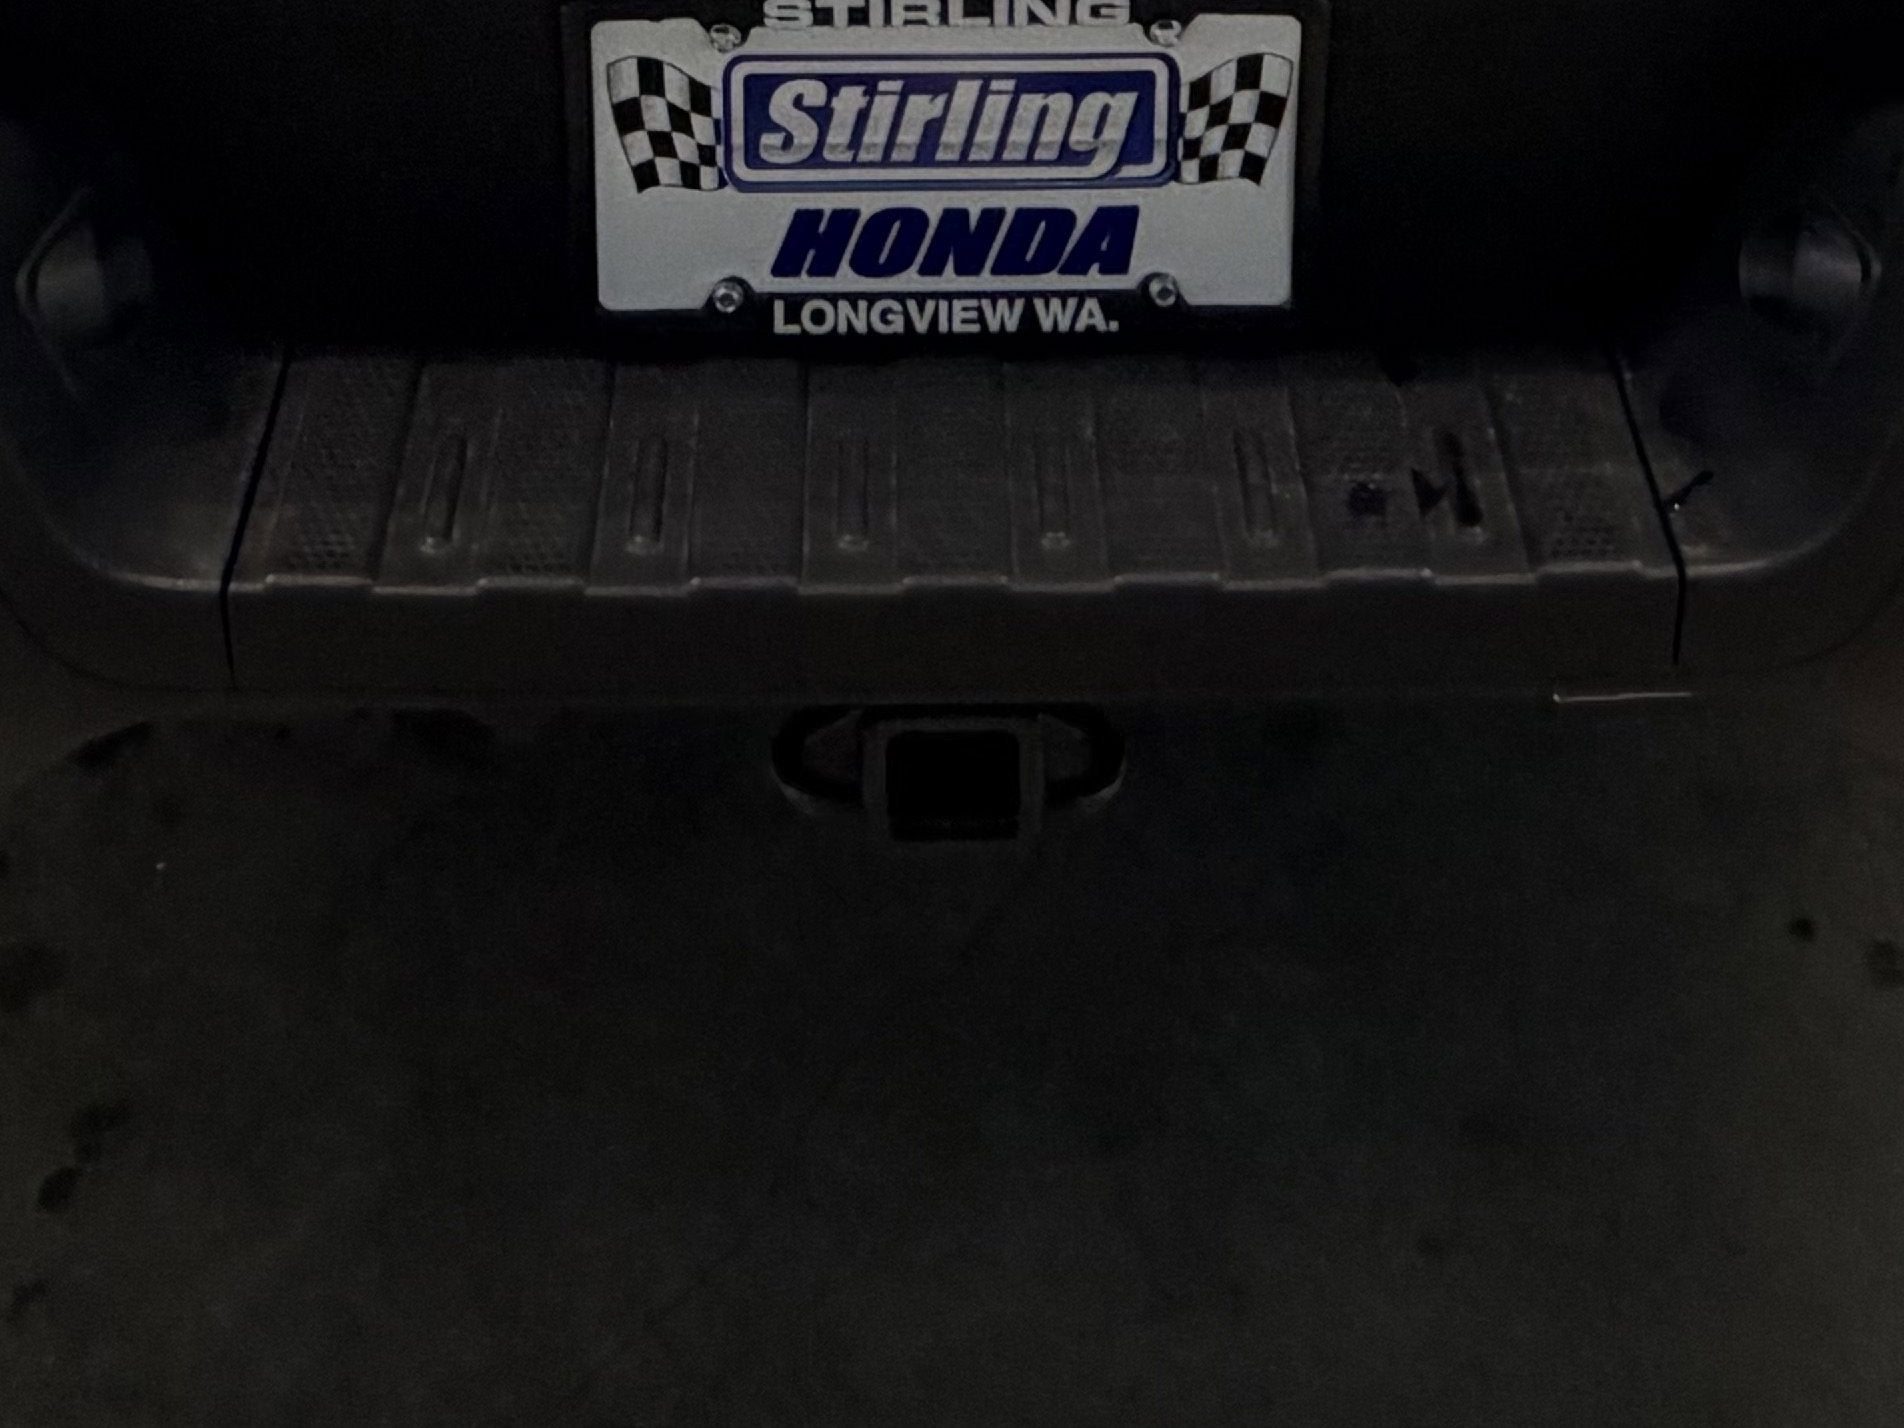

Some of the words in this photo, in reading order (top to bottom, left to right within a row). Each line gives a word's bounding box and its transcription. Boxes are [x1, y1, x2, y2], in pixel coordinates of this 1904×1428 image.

[758, 78, 1139, 180] Stirling
[770, 205, 1140, 278] HONDA
[773, 298, 1024, 335] LONGVIEW
[1033, 297, 1120, 333] WA.
